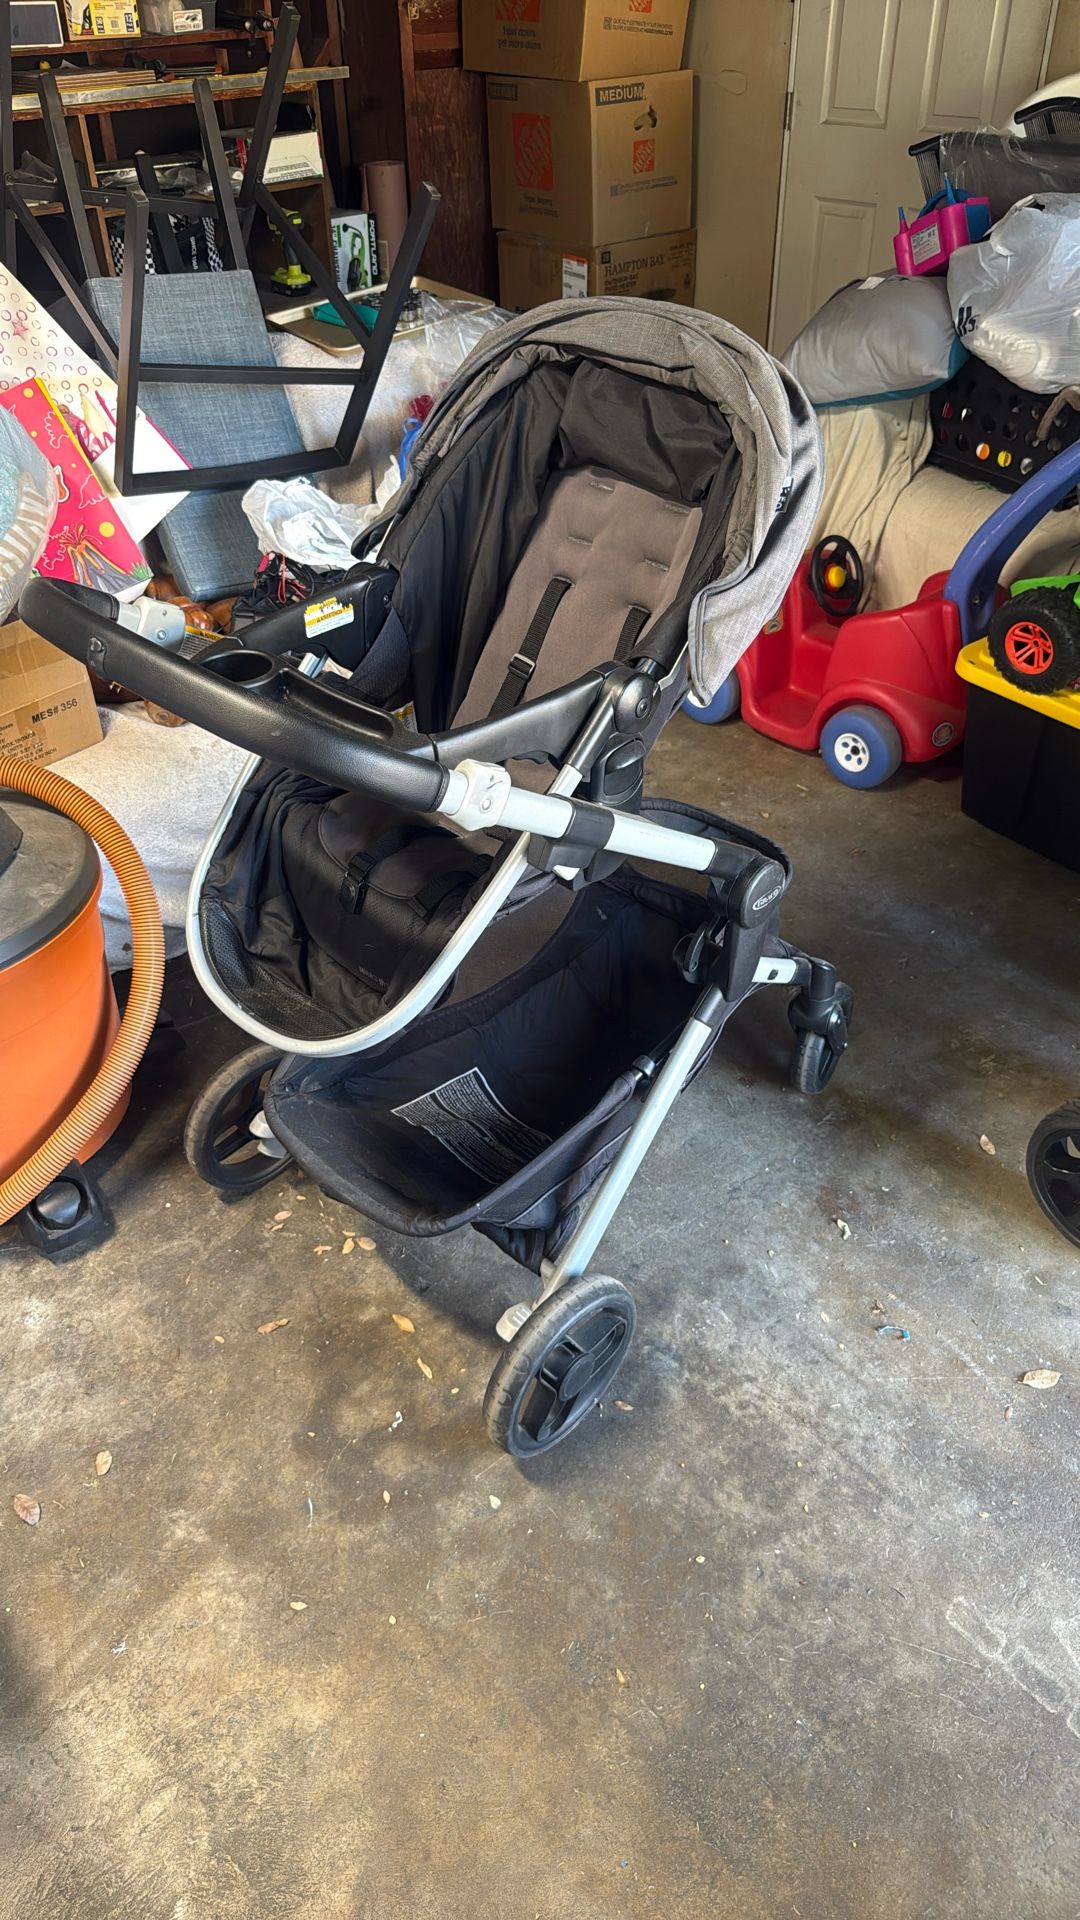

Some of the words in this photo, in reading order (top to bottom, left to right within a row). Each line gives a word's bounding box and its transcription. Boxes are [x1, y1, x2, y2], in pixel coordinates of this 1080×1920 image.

[125, 13, 133, 21] 12
[600, 86, 643, 103] MEDIUM
[369, 219, 379, 276] PORTLAND
[605, 257, 648, 277] HAMPTON
[31, 705, 59, 724] MES#
[60, 698, 78, 712] 356
